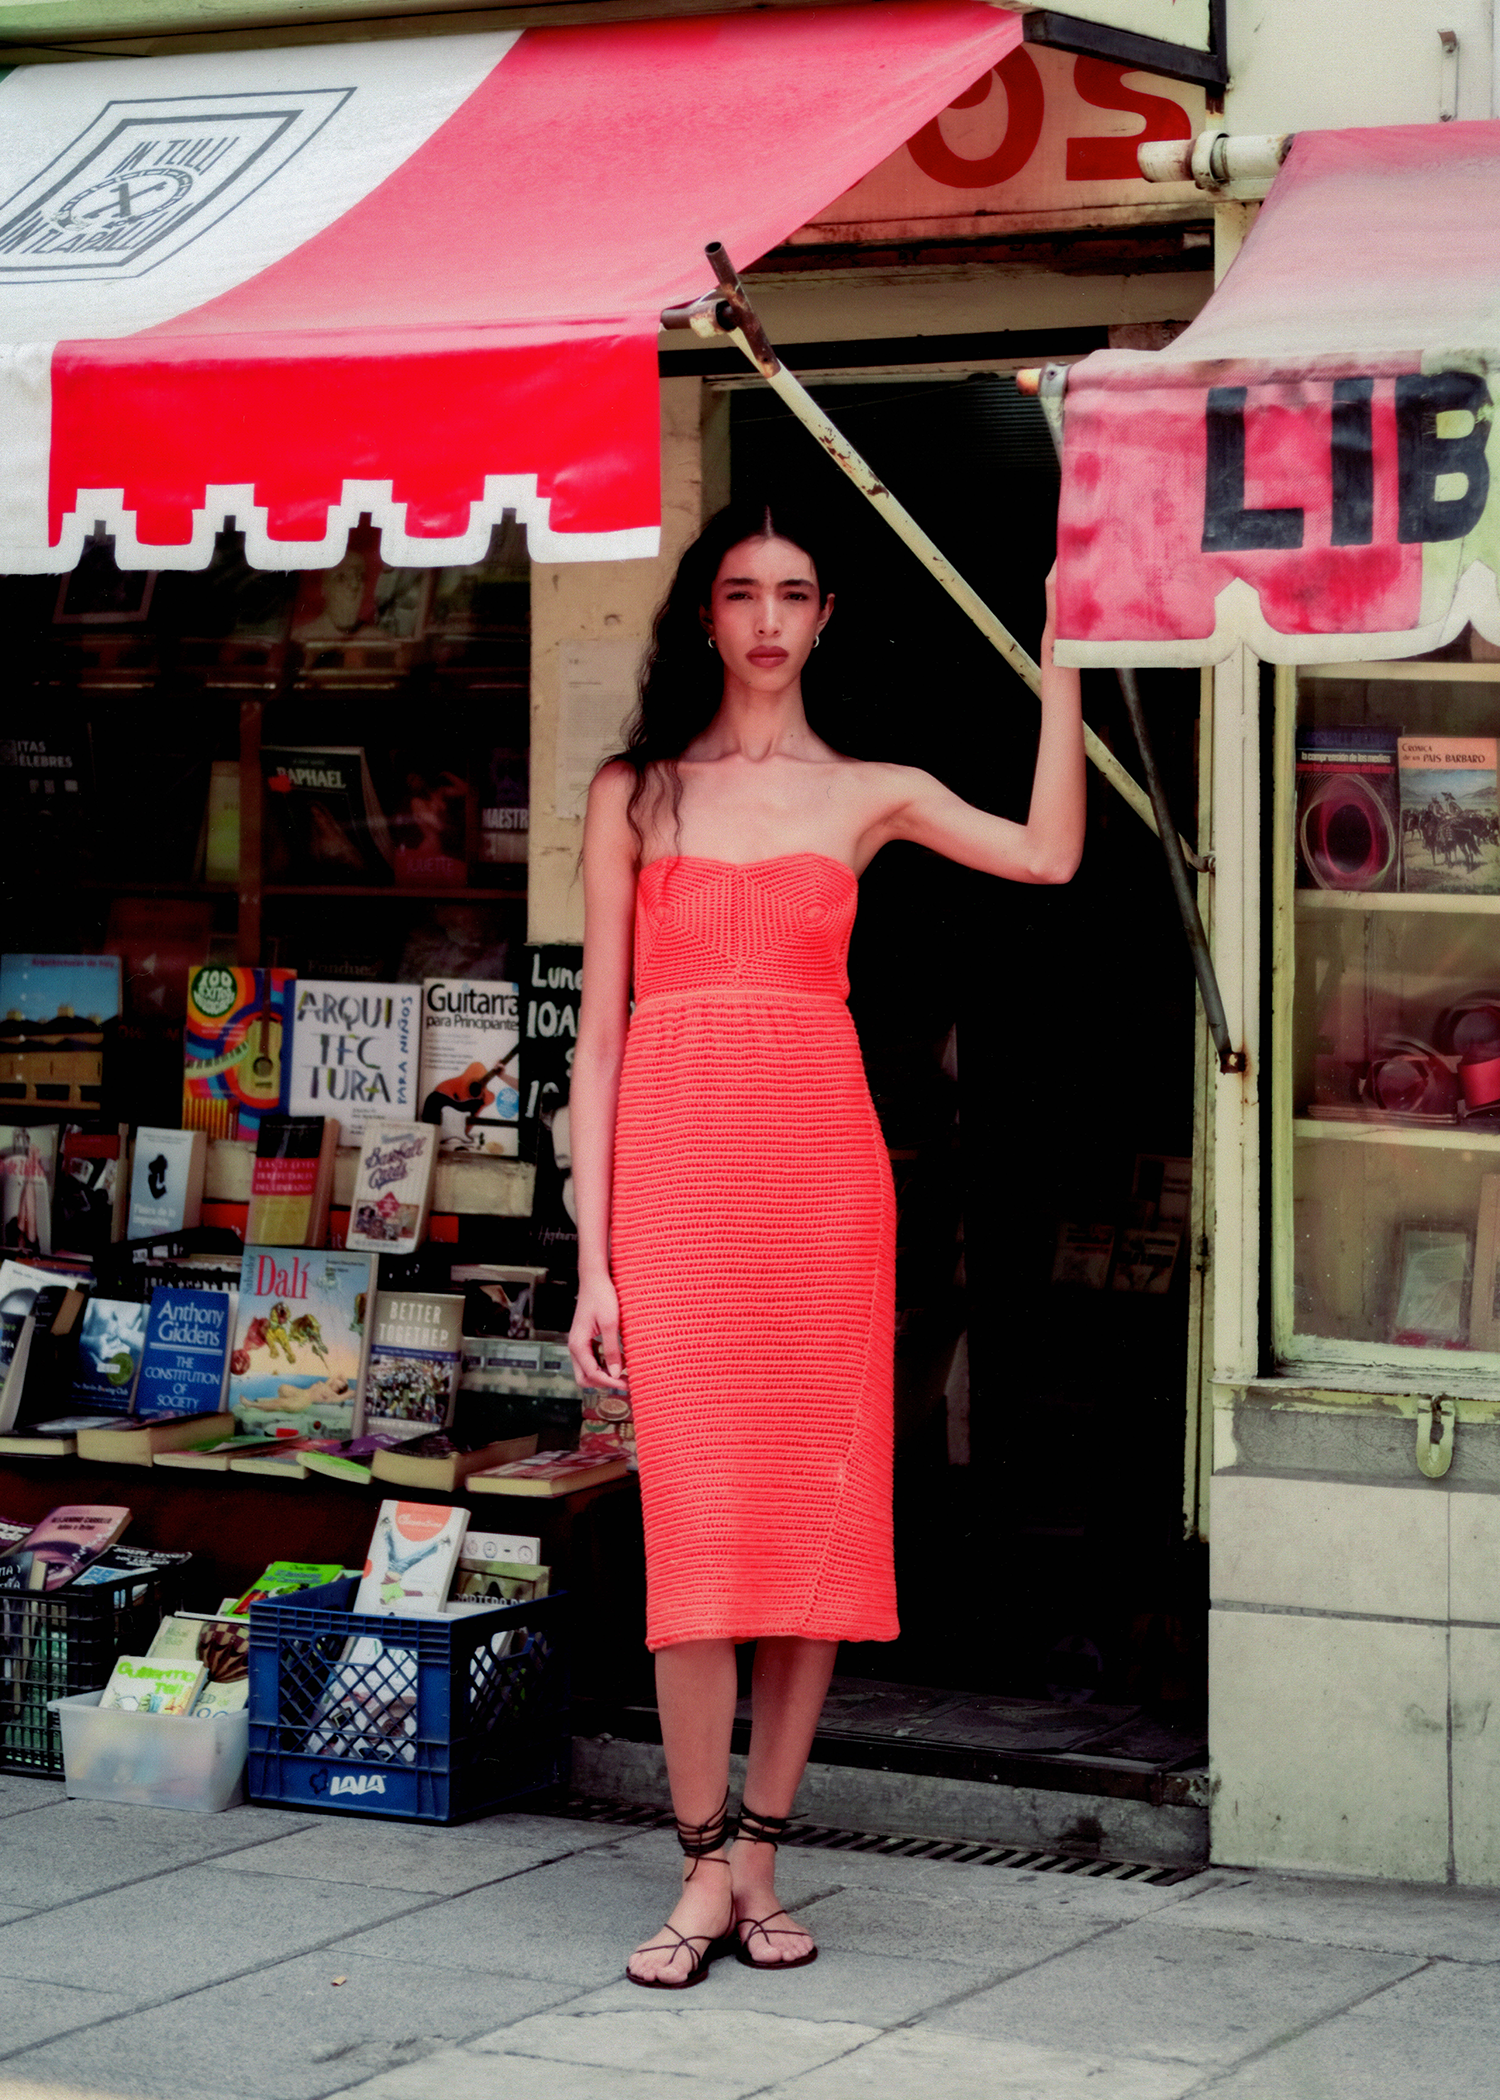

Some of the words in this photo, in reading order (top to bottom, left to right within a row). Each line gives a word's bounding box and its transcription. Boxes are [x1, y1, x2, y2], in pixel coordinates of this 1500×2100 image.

[105, 141, 160, 178] IN
[1201, 371, 1491, 552] LIB
[1445, 754, 1486, 763] BARBARO
[276, 766, 347, 789] RAPHAEL
[198, 970, 233, 988] 100
[297, 990, 393, 1031] ARQUI
[426, 1014, 451, 1030] para
[454, 1014, 519, 1033] Principiante
[303, 1064, 392, 1104] TURA
[255, 1254, 311, 1300] Dalí
[157, 1300, 225, 1328] Anthony
[389, 1301, 442, 1325] BETTER
[158, 1321, 220, 1347] Giddens
[379, 1323, 450, 1347] TOGETHER
[176, 1355, 194, 1369] THE
[145, 1367, 220, 1385] CONSTITUTION
[173, 1383, 188, 1395] OF
[156, 1394, 200, 1409] SOCIETY
[330, 1774, 386, 1797] LALA
